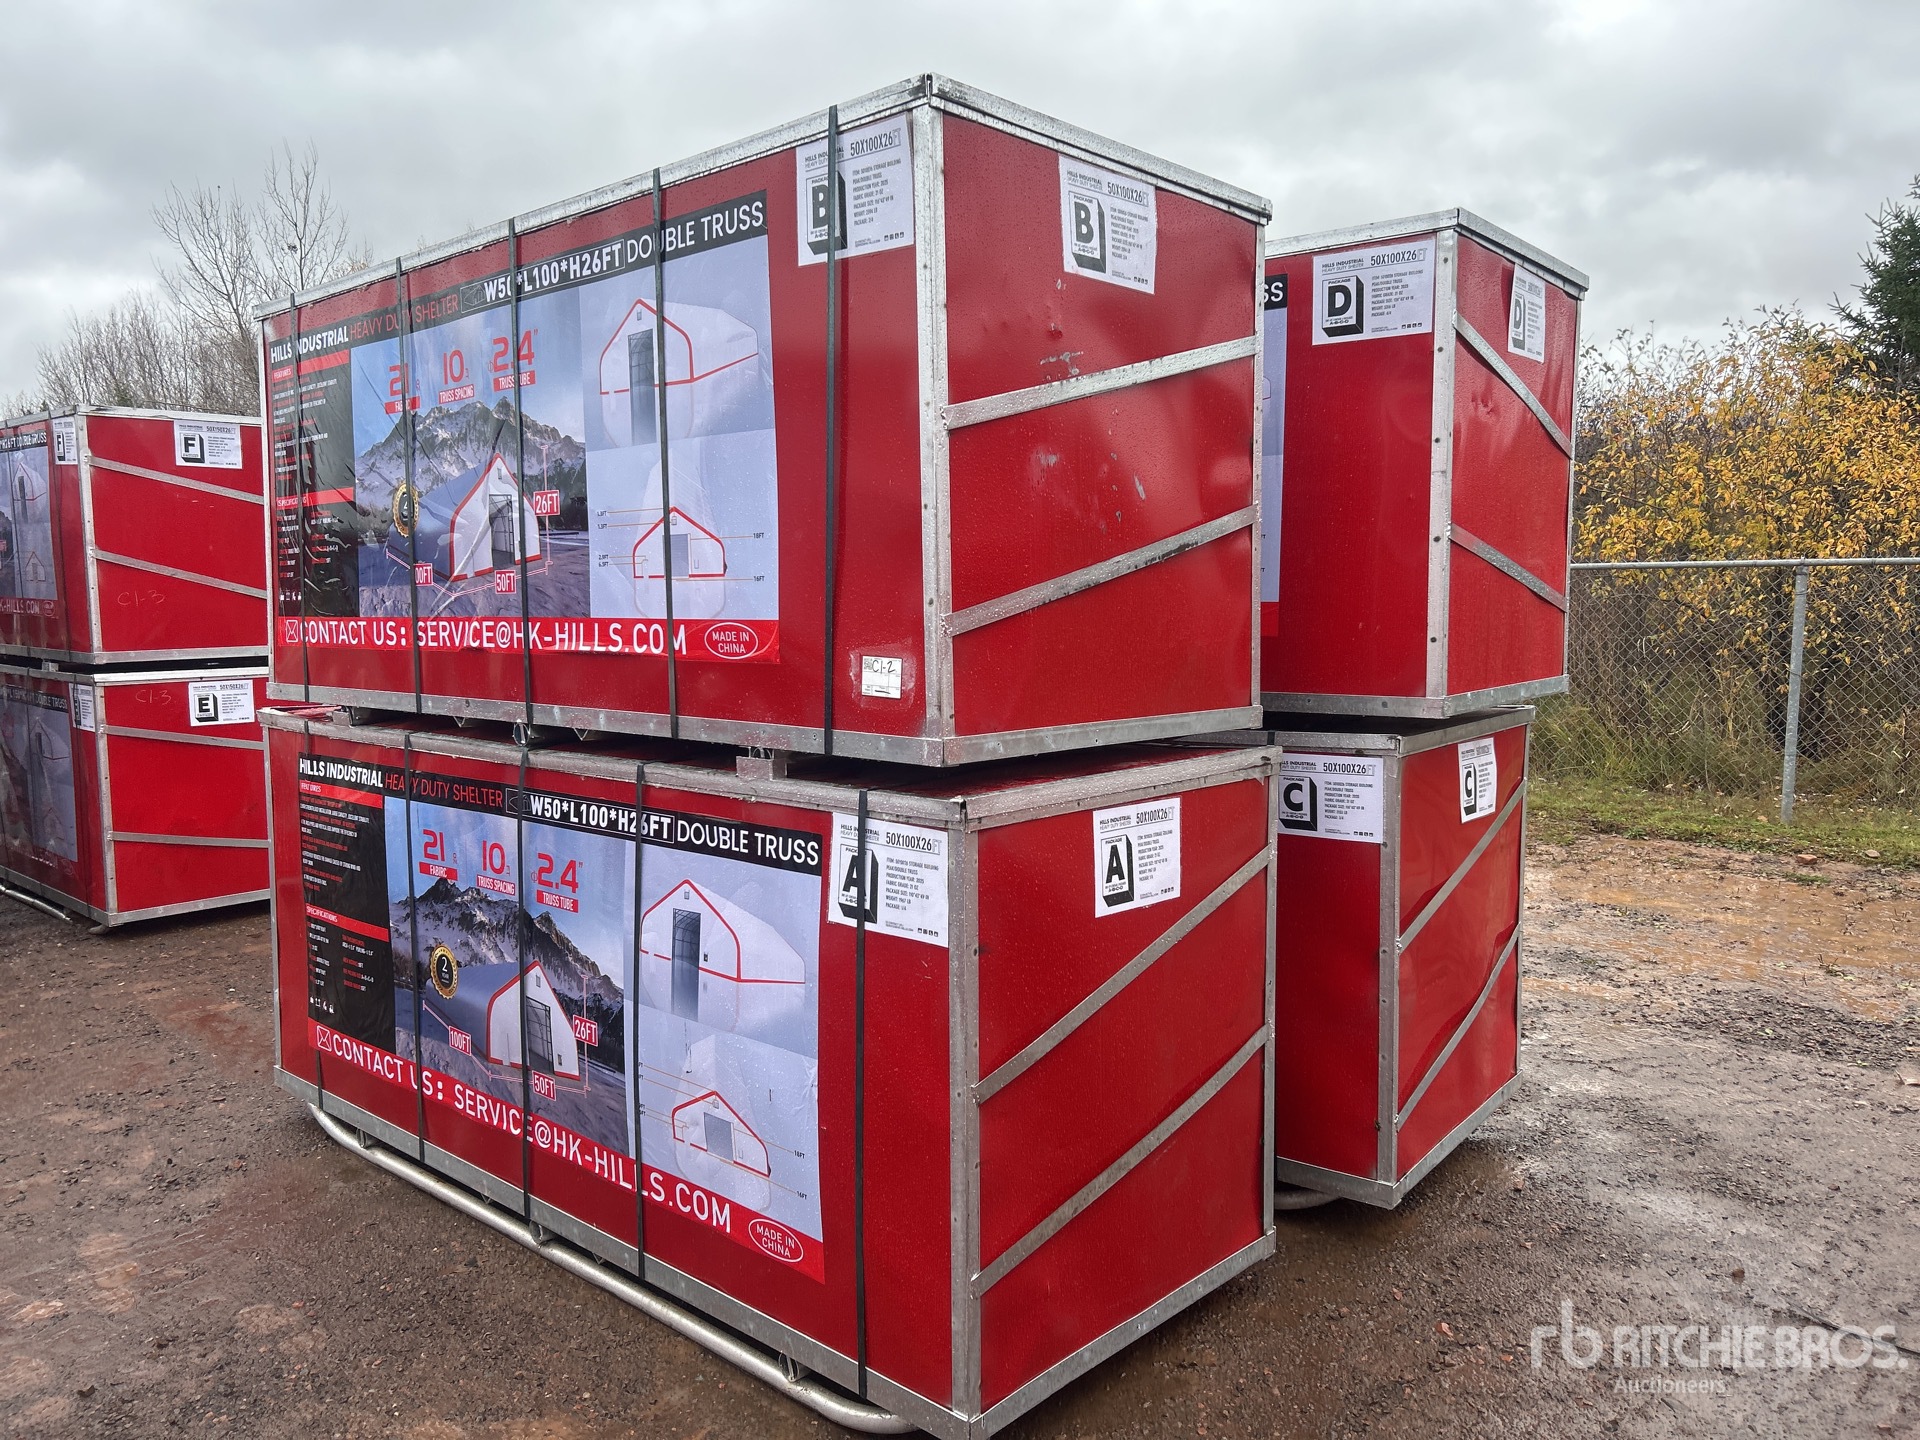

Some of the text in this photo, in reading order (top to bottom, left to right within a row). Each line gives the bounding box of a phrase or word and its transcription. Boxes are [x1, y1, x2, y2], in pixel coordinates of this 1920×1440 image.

[701, 201, 764, 241] TRUSS
[1074, 201, 1094, 244] B
[1328, 284, 1352, 318] D
[271, 341, 292, 364] HILLS
[351, 318, 383, 339] HEAVY
[415, 294, 459, 323] SHELTER
[443, 350, 465, 385] 10
[440, 386, 474, 403] TRUSS SPACING
[184, 436, 196, 453] F
[535, 493, 559, 514] 26FT
[414, 566, 432, 583] 00FT
[496, 574, 516, 591] 50FT
[301, 620, 367, 645] CONTACT
[372, 620, 407, 647] US:
[712, 630, 750, 642] MADE IN
[718, 642, 746, 654] CHINA
[198, 697, 210, 713] E
[300, 758, 326, 777] HILLS
[327, 762, 383, 787] INDUSTRIAL
[421, 778, 450, 802] DUTY
[453, 789, 503, 808] SHELTER
[1464, 769, 1473, 799] C
[1283, 782, 1303, 812] C
[840, 823, 852, 832] HILLS
[423, 828, 446, 862] 21
[677, 819, 749, 853] DOUBLE
[754, 831, 819, 866] TRUSS
[482, 840, 506, 875] 10
[1105, 844, 1125, 884] A
[478, 875, 515, 895] TRUSS SPACING
[542, 891, 574, 911] TRUSS TUBE
[449, 1030, 471, 1054] 100FT
[574, 1019, 597, 1044] 26FT
[332, 1034, 404, 1083] CONTACT
[534, 1077, 555, 1098] 50FT
[756, 1222, 796, 1249] MADE IN
[762, 1238, 791, 1258] CHINA
